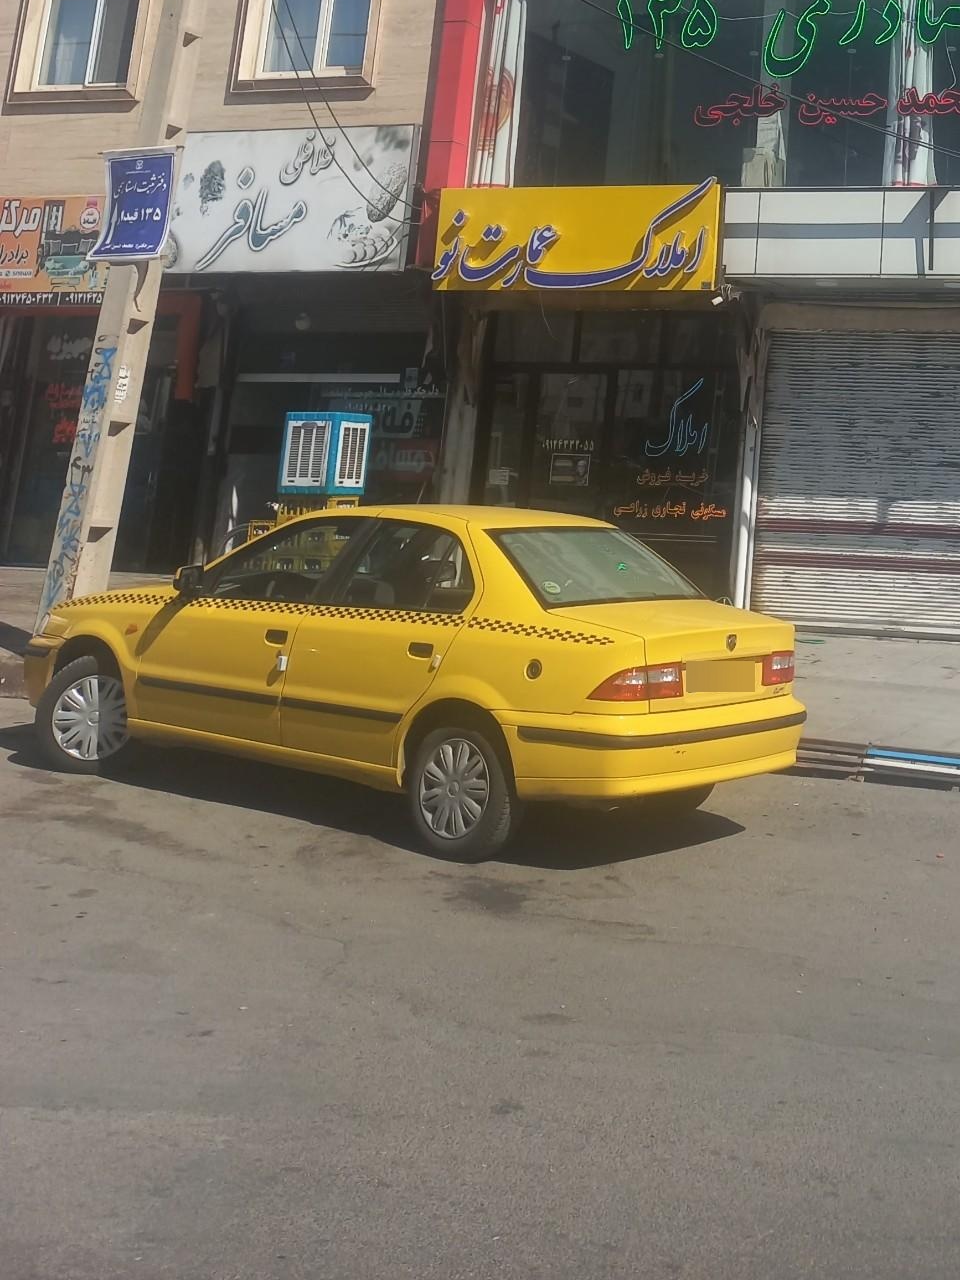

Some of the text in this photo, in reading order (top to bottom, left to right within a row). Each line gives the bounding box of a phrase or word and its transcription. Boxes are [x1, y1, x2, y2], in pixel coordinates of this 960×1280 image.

[694, 83, 788, 127] خلجی
[798, 90, 888, 126] حسین
[141, 207, 162, 221] ۱۳۵
[194, 166, 308, 271] مسافر
[524, 176, 718, 289] املاک
[644, 376, 709, 457] املاک
